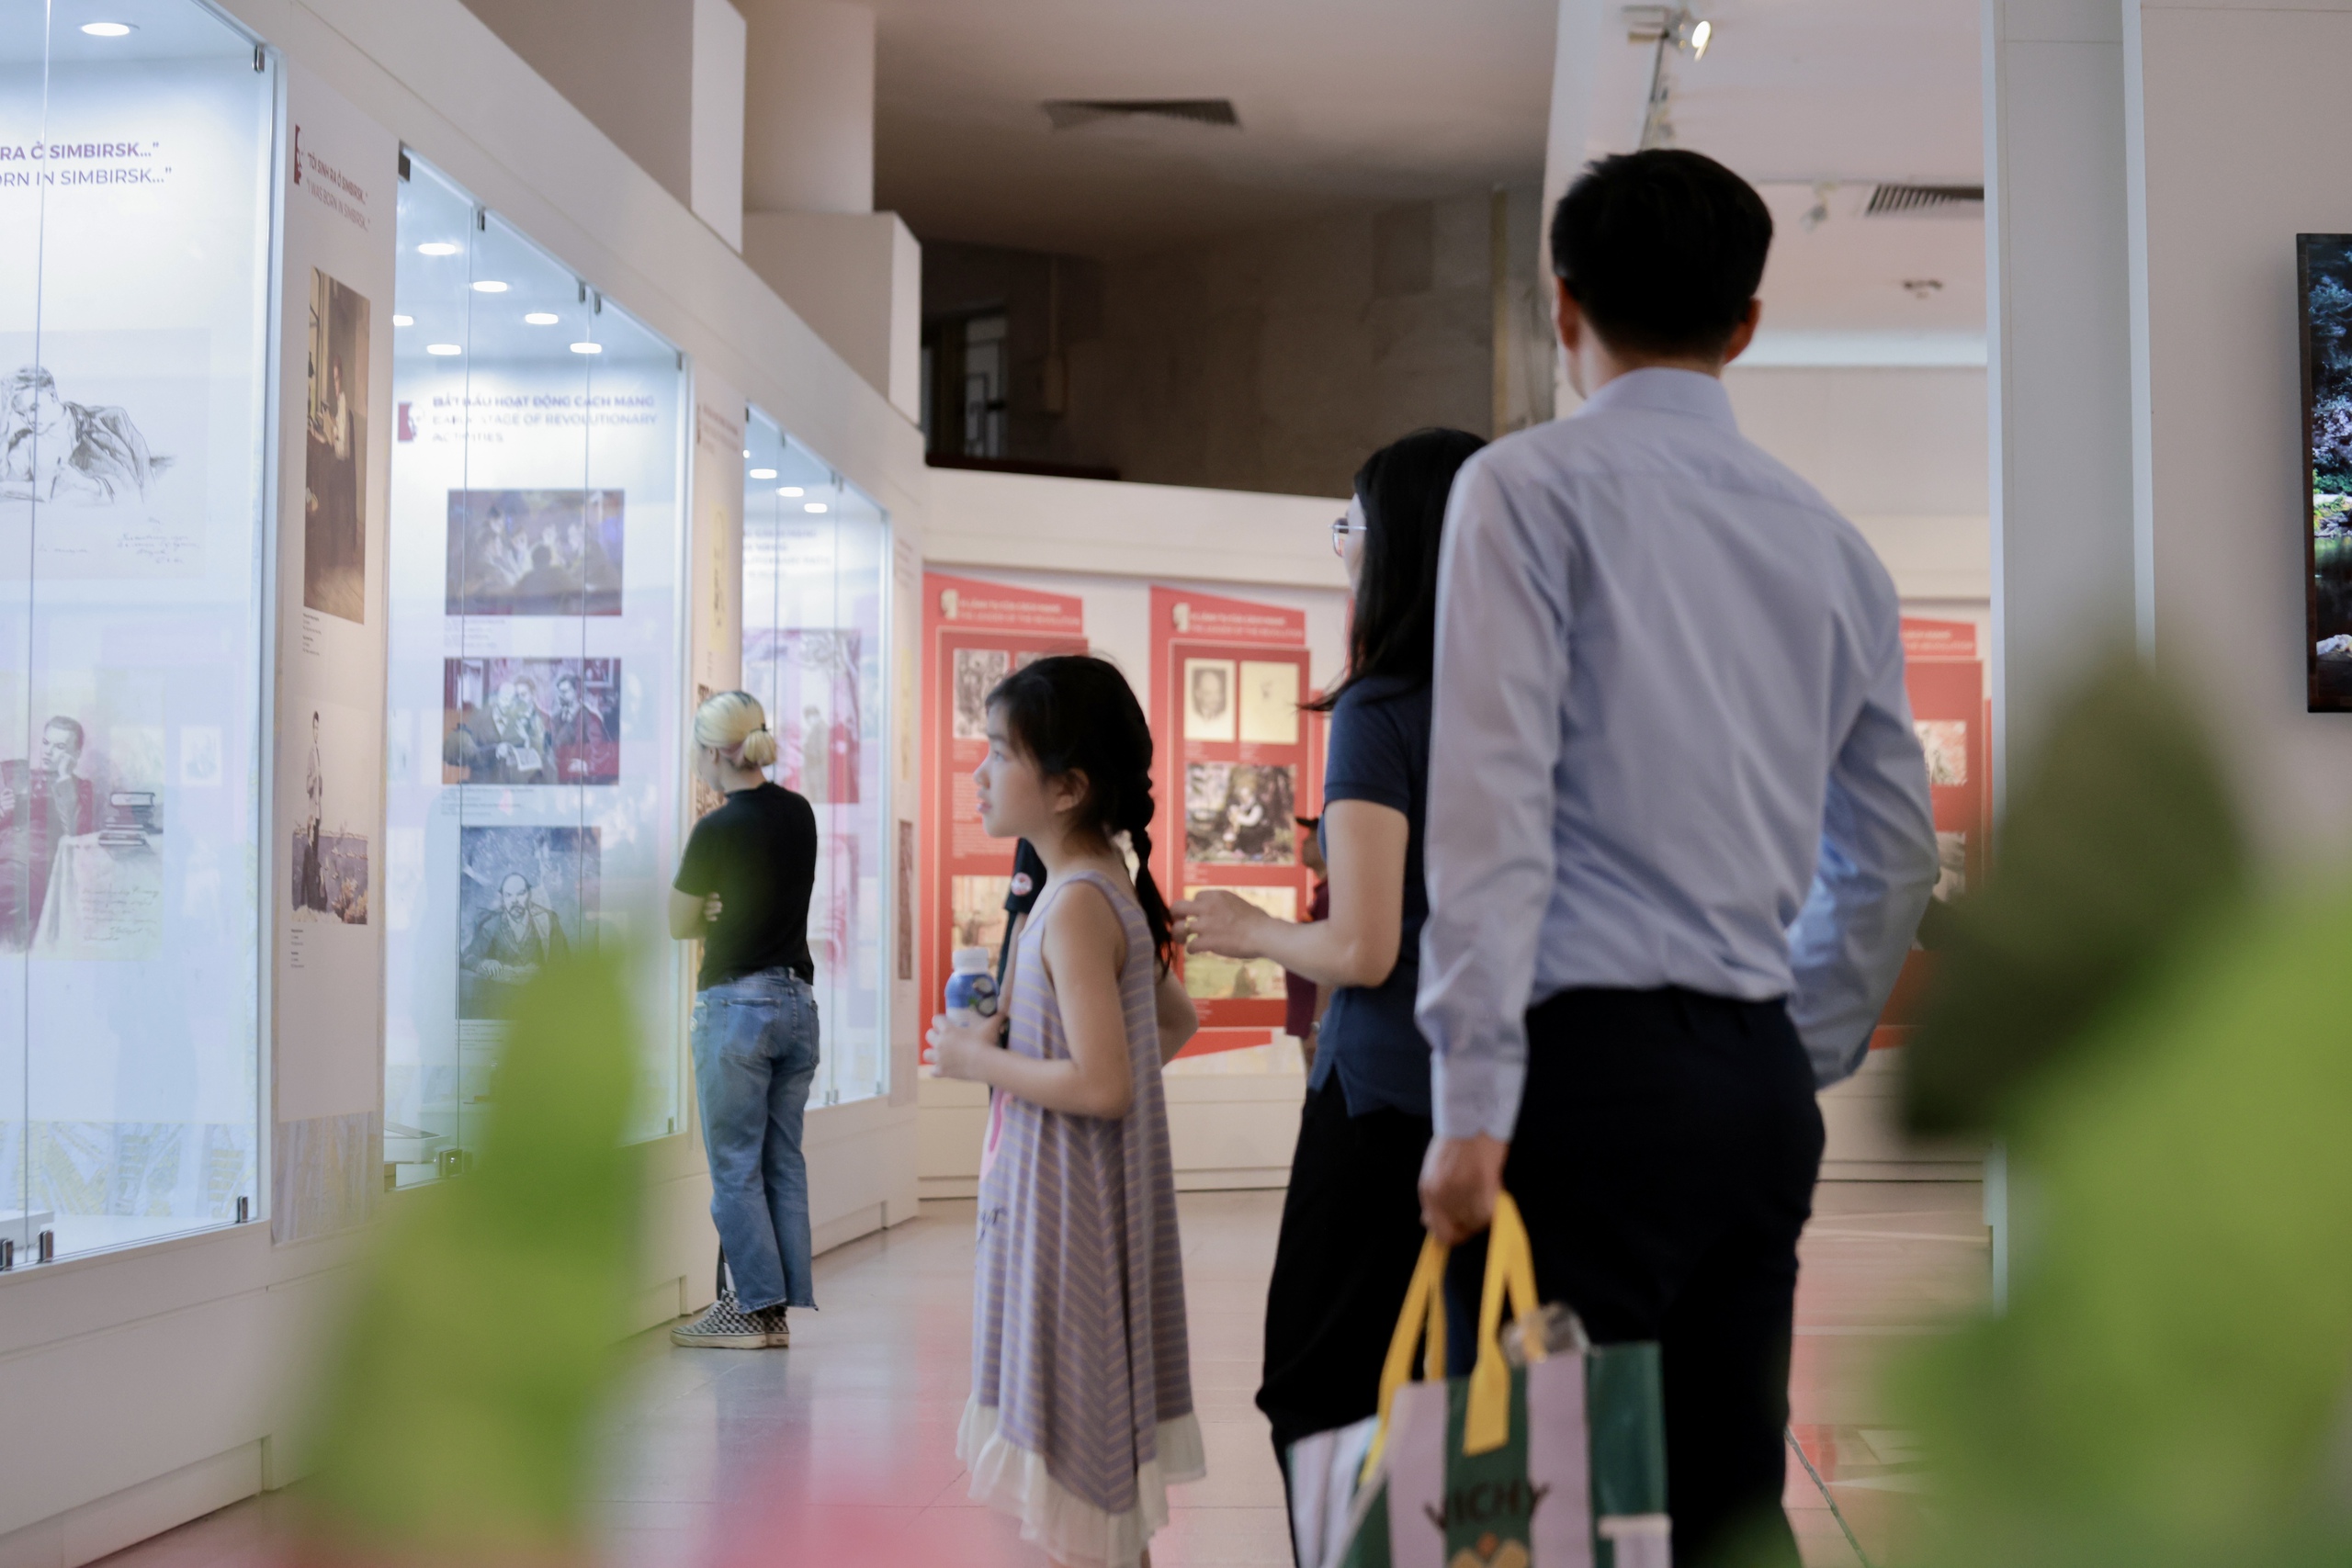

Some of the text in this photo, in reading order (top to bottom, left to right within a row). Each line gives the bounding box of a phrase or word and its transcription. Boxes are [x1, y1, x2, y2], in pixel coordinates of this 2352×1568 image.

[0, 146, 26, 161] RA
[37, 171, 54, 186] IN
[1424, 1478, 1552, 1530] VICHY
